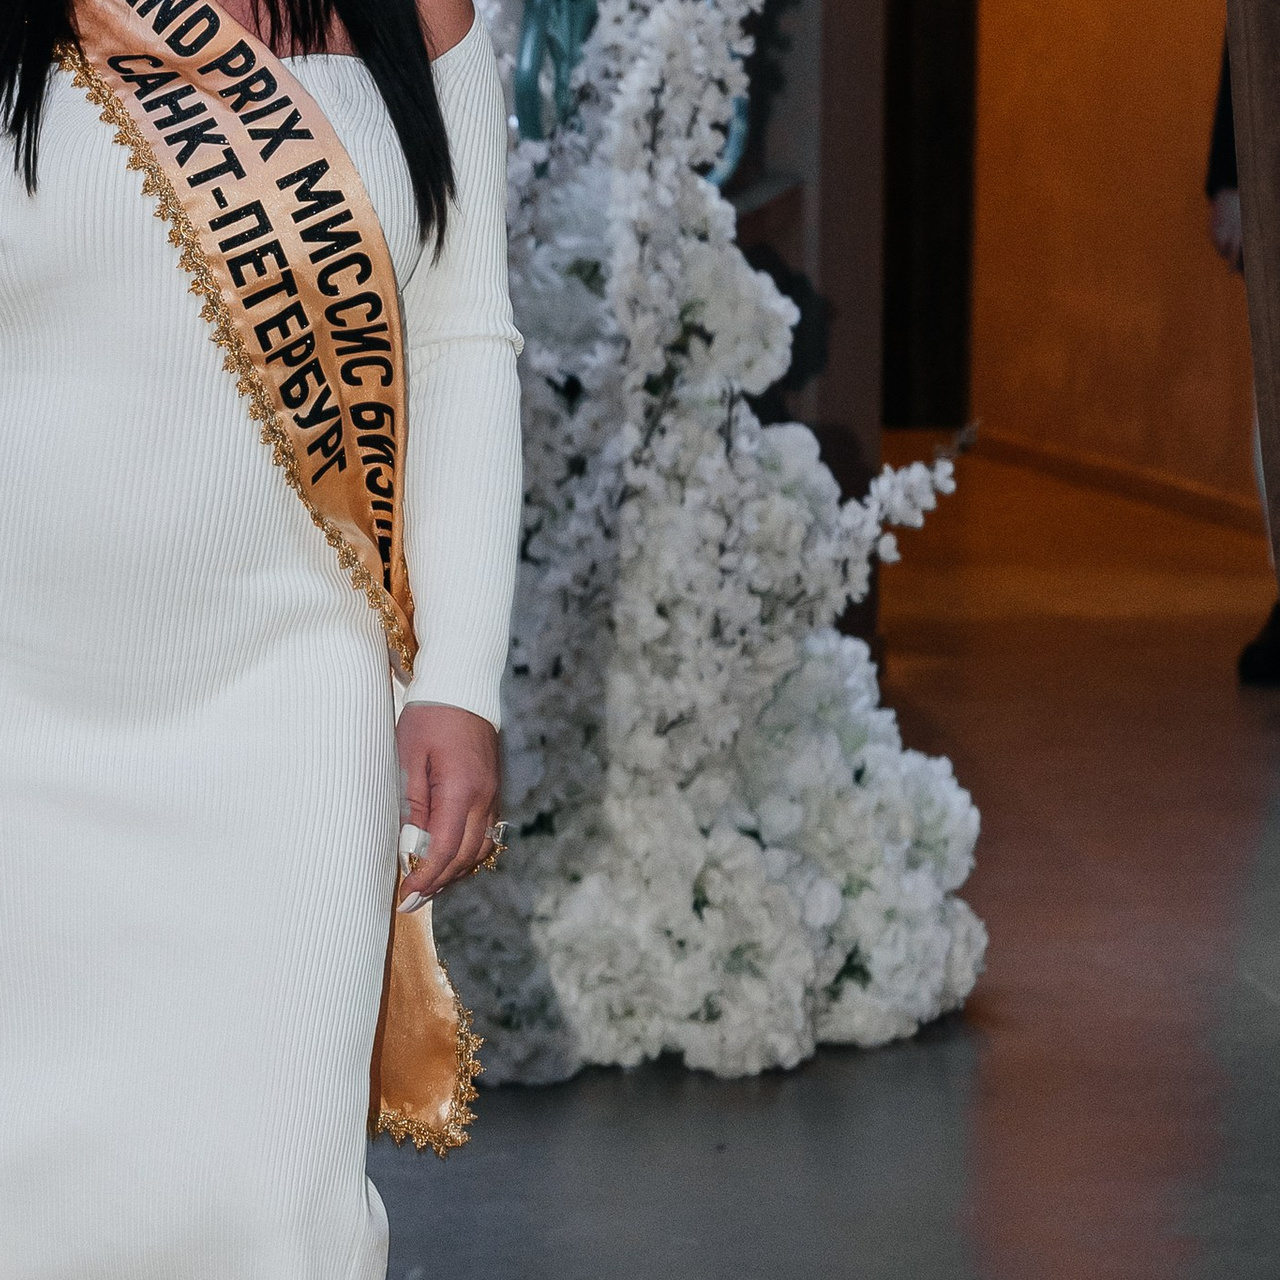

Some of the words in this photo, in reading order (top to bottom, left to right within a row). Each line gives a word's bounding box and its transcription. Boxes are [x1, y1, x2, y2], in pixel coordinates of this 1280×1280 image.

[107, 54, 347, 486] САНКТ-ПЕТЕРБУРГ
[197, 39, 315, 163] PRIX
[275, 157, 394, 388] МИССИС
